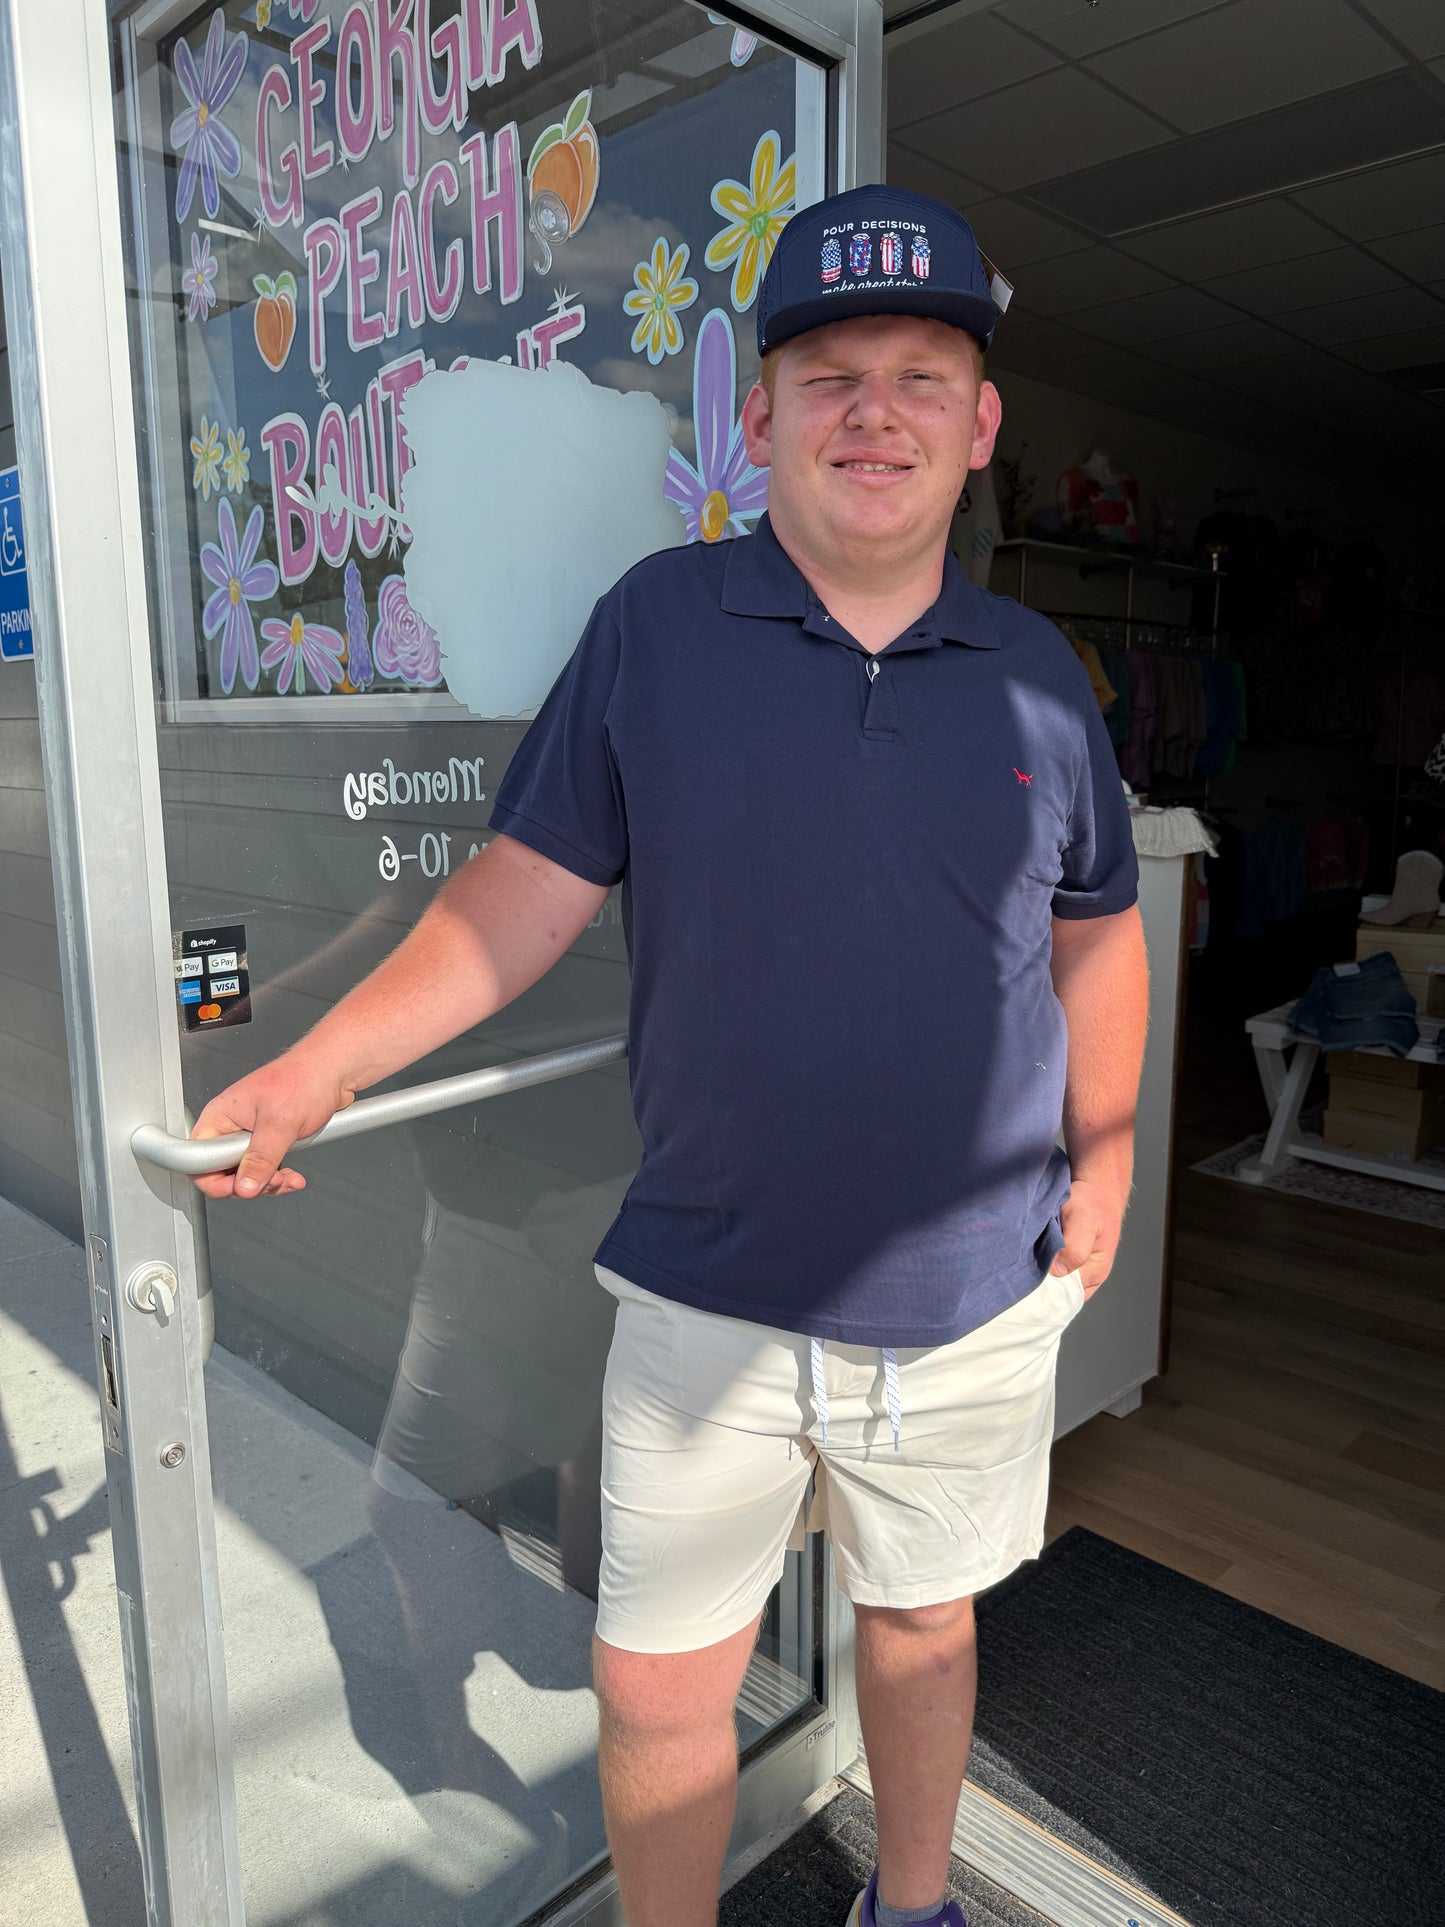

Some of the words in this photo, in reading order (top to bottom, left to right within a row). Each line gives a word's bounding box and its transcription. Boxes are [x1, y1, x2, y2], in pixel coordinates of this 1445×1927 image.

[256, 0, 541, 228] GEORGIA
[823, 223, 854, 238] POUR
[861, 220, 927, 234] DECISIONS
[303, 121, 524, 376] PEACH
[1, 608, 32, 635] PARKIN
[185, 963, 200, 973] Pay
[220, 958, 235, 968] Pay
[215, 982, 236, 992] VISA
